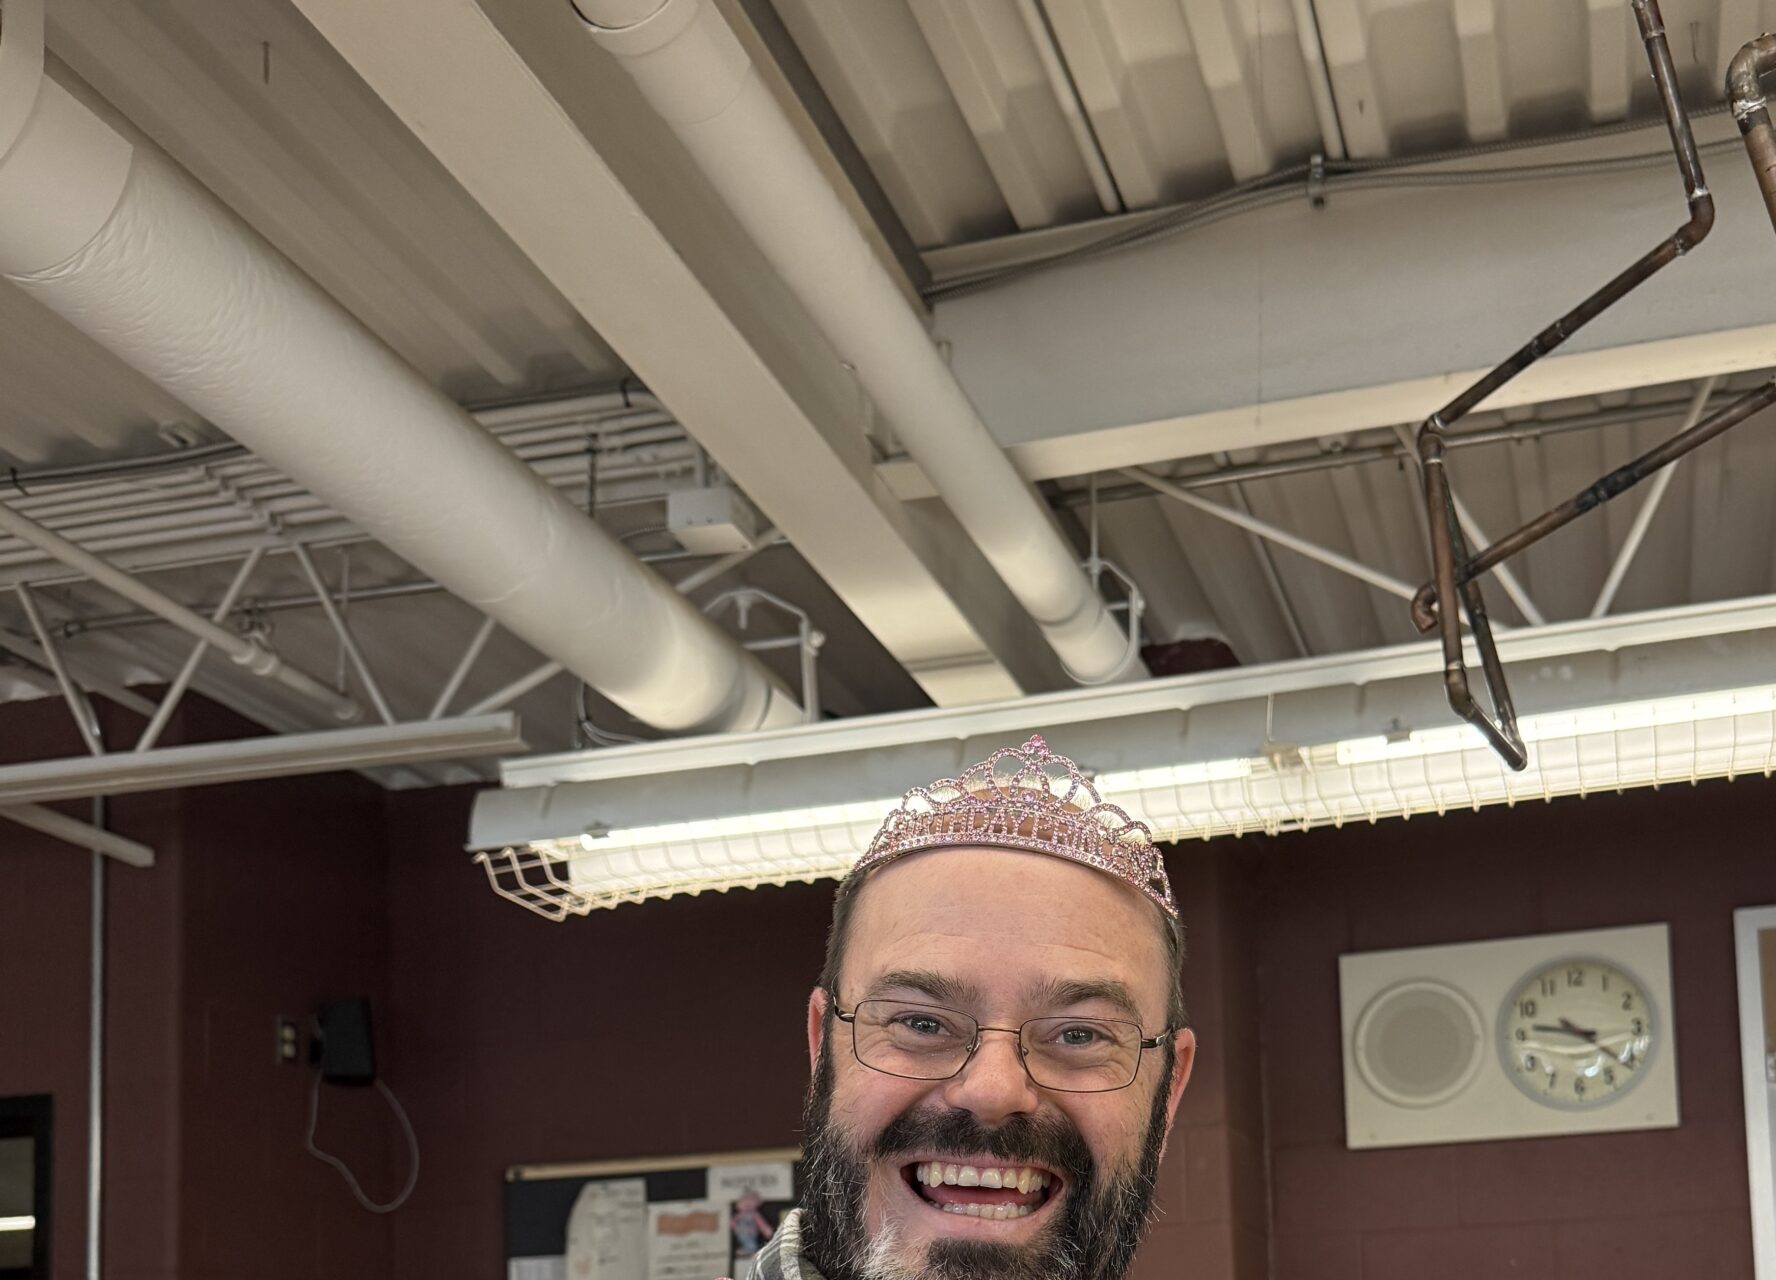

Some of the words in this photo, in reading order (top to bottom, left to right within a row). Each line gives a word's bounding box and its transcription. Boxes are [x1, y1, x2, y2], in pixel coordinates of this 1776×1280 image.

[894, 806, 1029, 842] BIRTHDAY
[1567, 968, 1584, 987] 12
[1602, 975, 1608, 992] 1
[1541, 978, 1555, 996] 11
[1519, 1000, 1536, 1017] 10
[1622, 991, 1632, 1011] 2
[1515, 1027, 1526, 1042] 9
[1631, 1017, 1643, 1035] 3
[1603, 1066, 1614, 1085] 5
[1574, 1077, 1585, 1095] 6
